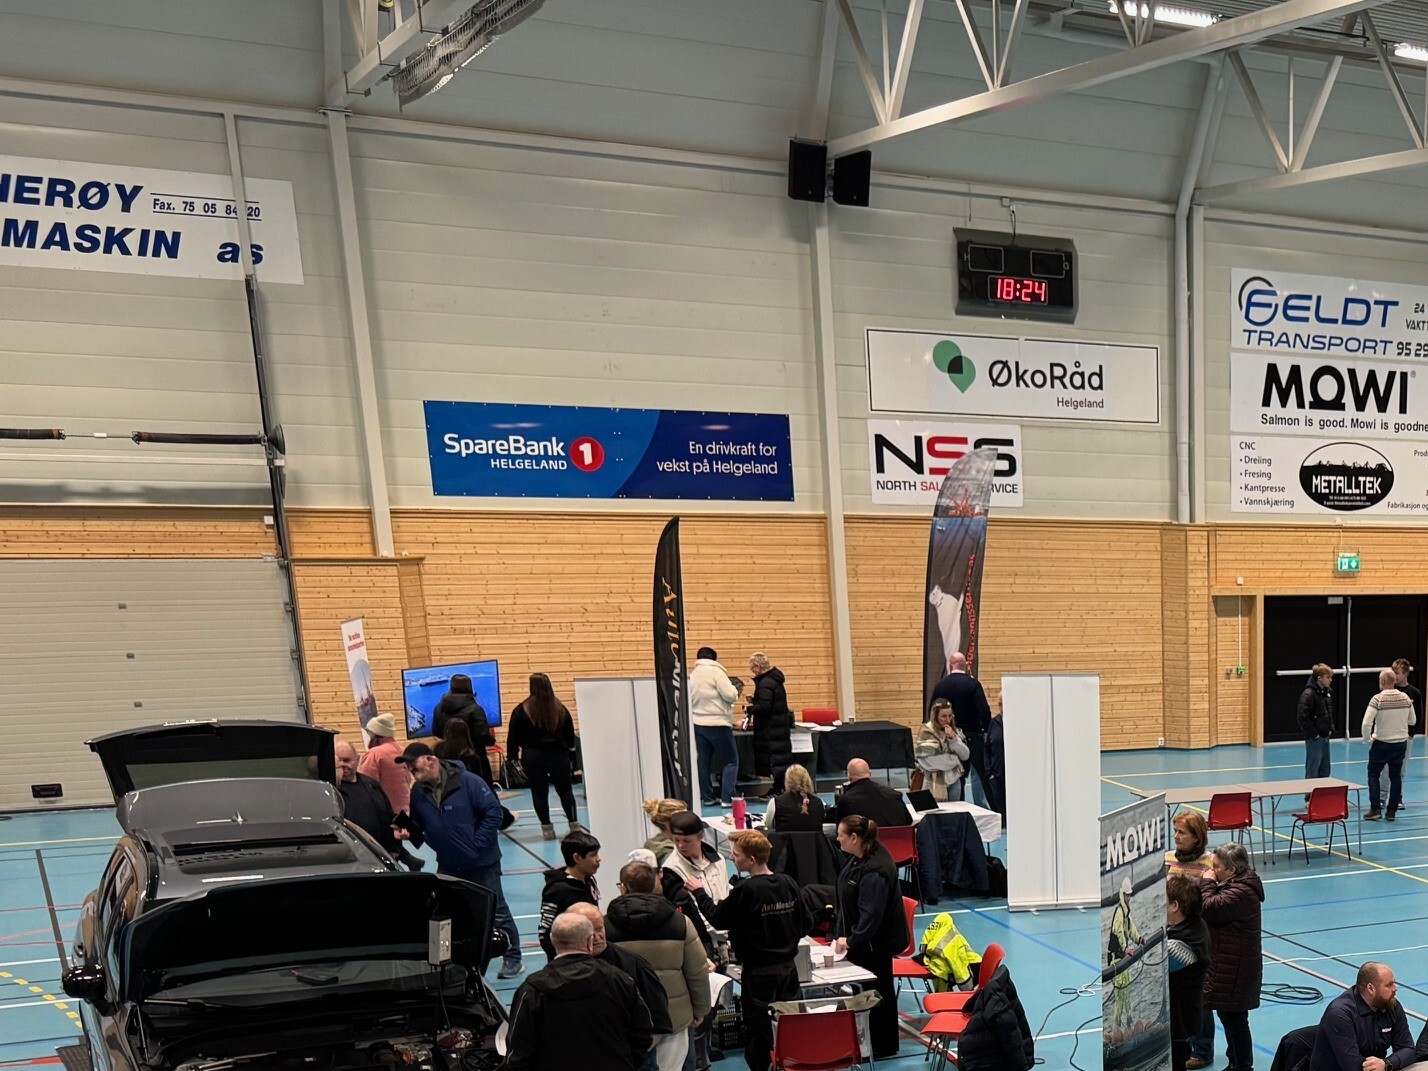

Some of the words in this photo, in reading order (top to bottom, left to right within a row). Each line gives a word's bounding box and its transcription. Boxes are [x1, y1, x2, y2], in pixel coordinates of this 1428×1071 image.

[152, 198, 175, 211] Fax.
[182, 200, 195, 213] 75
[203, 203, 217, 214] 05
[247, 206, 261, 218] 20
[1, 218, 181, 259] MASKIN
[216, 241, 264, 265] as
[996, 278, 1046, 302] 18:24
[1414, 303, 1425, 314] 24
[1242, 329, 1393, 356] TRANSPORT
[1396, 341, 1411, 356] 95
[988, 359, 1104, 391] ØkoRåd
[1261, 363, 1408, 415] MOWI
[1056, 397, 1104, 409] Helgeland
[1261, 413, 1300, 427] Salmon
[1304, 416, 1313, 427] is
[1318, 417, 1348, 429] good.
[1350, 418, 1376, 430] Mowi
[1380, 419, 1389, 430] is
[443, 433, 566, 458] SpareBank
[578, 442, 593, 465] 1
[689, 441, 703, 454] En
[706, 441, 757, 456] drivkraft
[759, 443, 777, 456] for
[1239, 441, 1256, 450] CNC
[490, 457, 568, 470] HELGELAND
[656, 459, 690, 473] vekst
[692, 460, 710, 475] på
[713, 461, 778, 477] Helgeland
[1244, 456, 1272, 467] Dreiing
[1244, 470, 1272, 480] Fresing
[876, 480, 917, 491] NORTH
[990, 483, 1018, 494] RVICE
[1244, 484, 1286, 493] Kantpresse
[1312, 475, 1382, 494] METALLTEK
[1244, 497, 1295, 508] Vannskjæring
[1387, 501, 1420, 511] Fabrikasjon
[1106, 816, 1161, 871] MOWI
